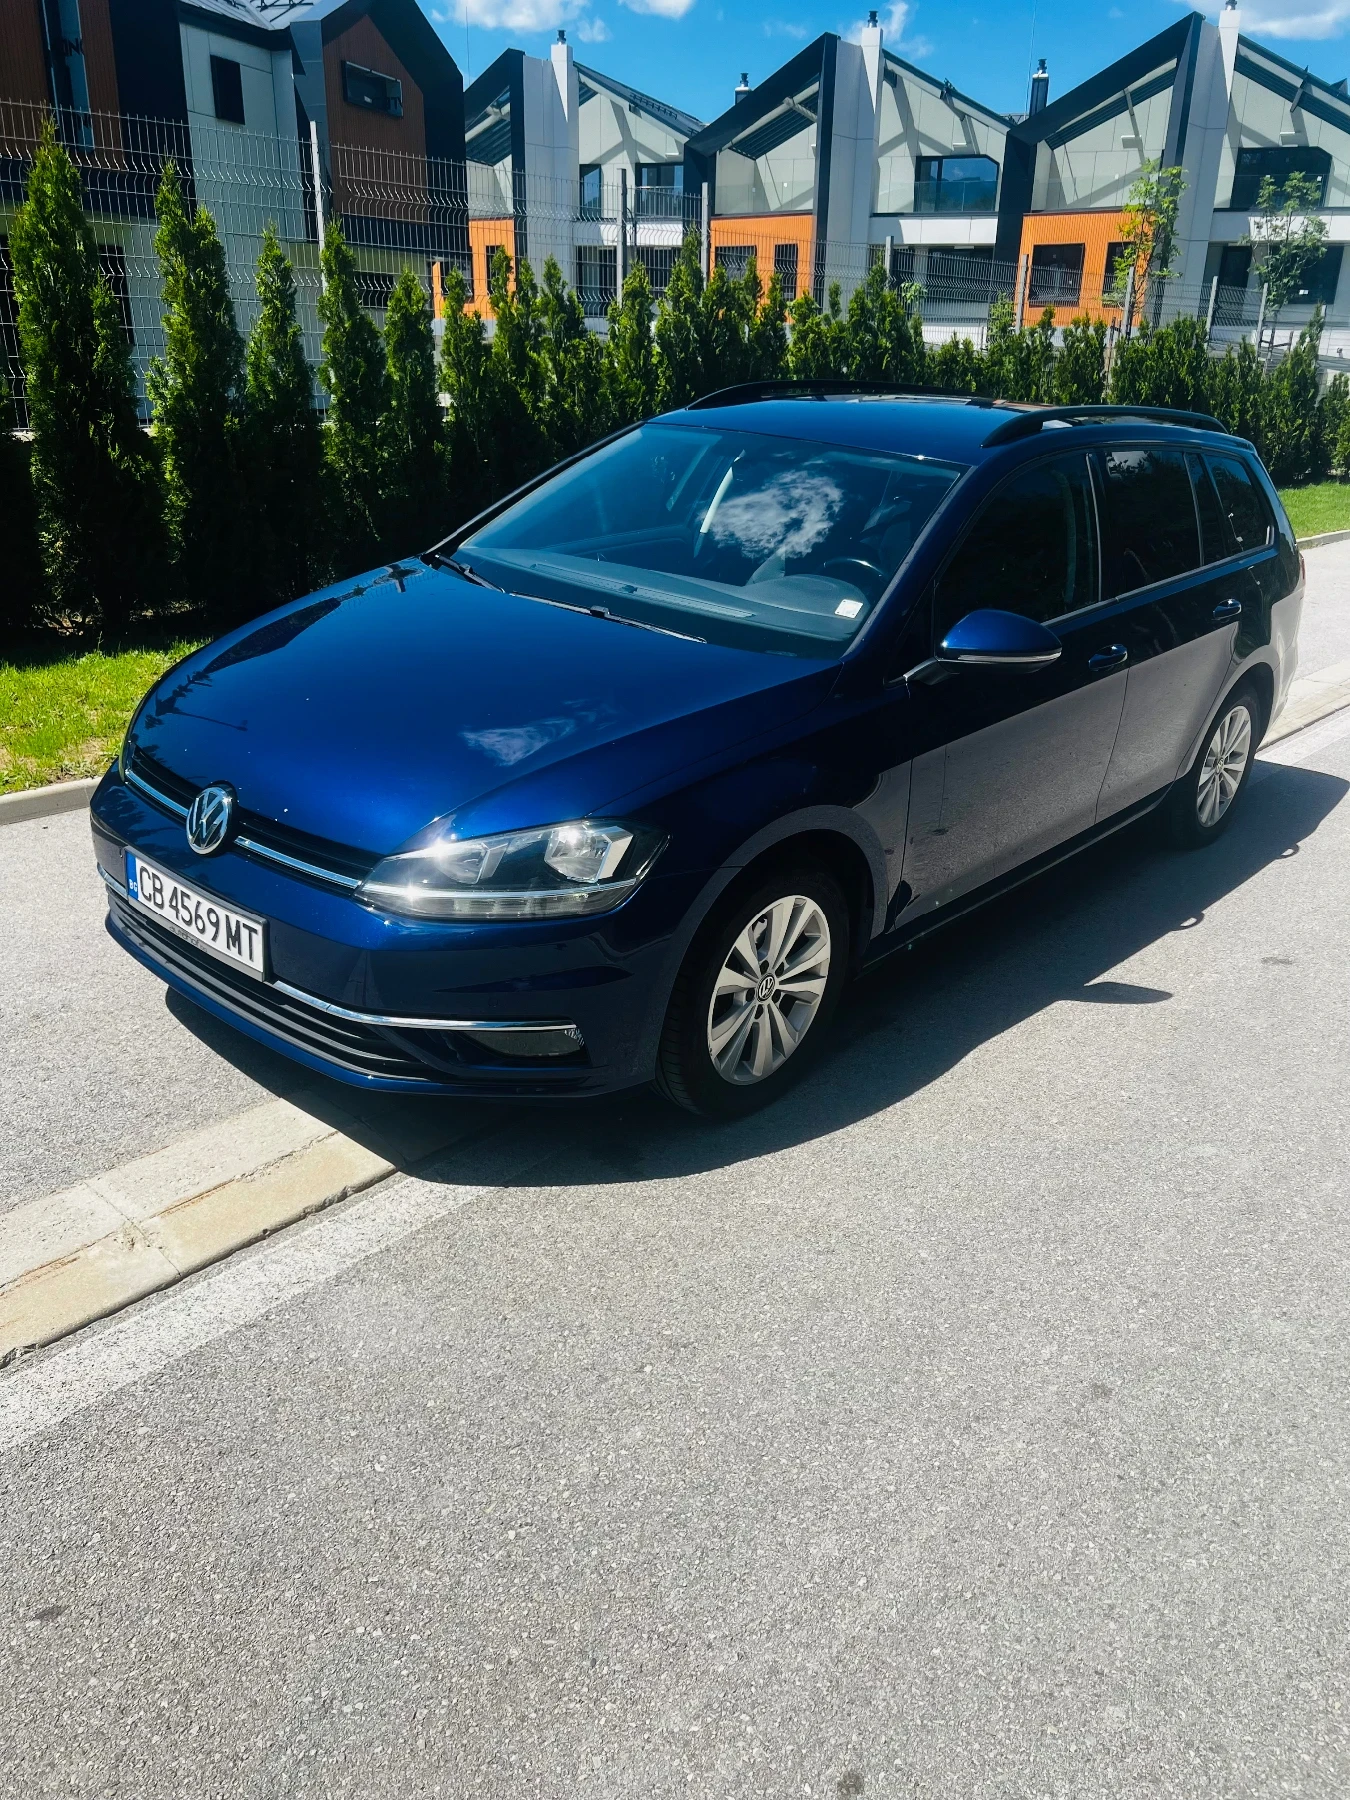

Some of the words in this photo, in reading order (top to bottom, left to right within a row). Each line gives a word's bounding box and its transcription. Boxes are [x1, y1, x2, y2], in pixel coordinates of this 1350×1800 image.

[129, 878, 138, 893] BG
[139, 865, 165, 910] CB
[168, 886, 220, 942] 4569
[224, 913, 258, 962] MT
